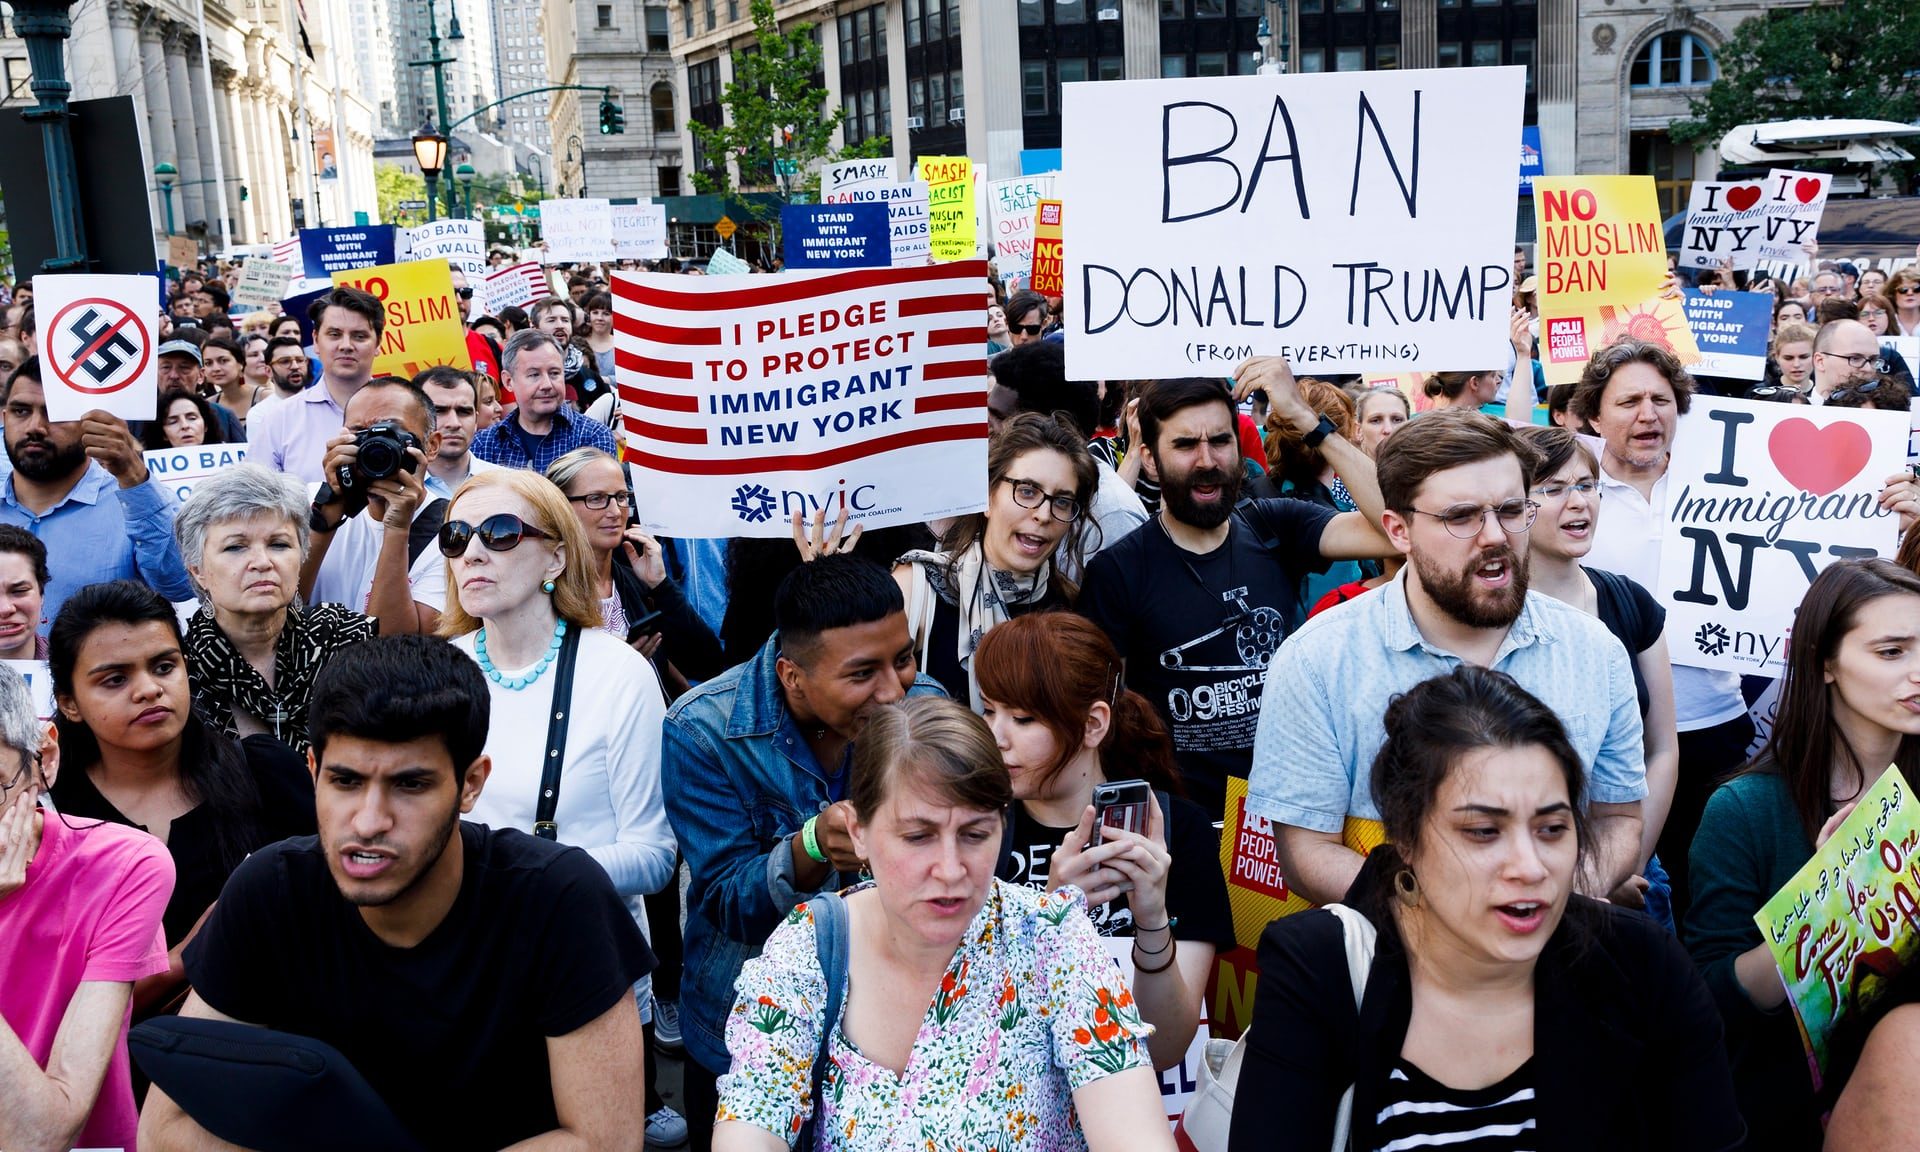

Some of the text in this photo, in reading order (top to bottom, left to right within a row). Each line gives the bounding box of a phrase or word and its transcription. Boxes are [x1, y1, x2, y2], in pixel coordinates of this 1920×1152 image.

[1162, 90, 1422, 223] BAN
[833, 164, 887, 184] SMASH
[925, 163, 967, 181] SMASH
[853, 188, 912, 201] NO BAN
[1773, 175, 1792, 201] I
[1543, 189, 1597, 222] NO
[1702, 187, 1721, 211] I
[611, 216, 658, 228] NTEGRITY
[811, 213, 855, 223] I STAND
[929, 211, 964, 222] MUSLIM
[999, 216, 1030, 234] OUT
[1688, 204, 1768, 229] Immigrant
[334, 233, 367, 242] STAND
[412, 224, 469, 243] NO BAN
[818, 225, 848, 235] WITH
[889, 223, 927, 237] AIDS
[1688, 225, 1760, 252] NY
[336, 243, 361, 251] WITH
[802, 237, 867, 247] IMMIGRANT
[997, 239, 1031, 256] NEW
[1546, 223, 1659, 258] MUSLIM
[321, 251, 378, 262] IMMIGRANT
[413, 247, 432, 261] NO
[437, 243, 480, 255] WALL
[806, 249, 865, 259] NEW YORK
[325, 260, 377, 271] NEW YORK
[464, 262, 484, 274] IDS
[1546, 259, 1606, 294] BAN
[489, 286, 529, 305] IMMIGRANT
[496, 279, 526, 295] PROTECT
[510, 295, 528, 305] YORK
[1082, 261, 1510, 335] DONALD TRUMP
[1690, 297, 1733, 308] STAND
[383, 296, 451, 327] SLIM
[1689, 309, 1723, 319] WITH
[734, 299, 887, 346] I PLEDGE
[1551, 321, 1582, 335] ACLU
[1551, 334, 1583, 347] PEOPLE
[1703, 333, 1739, 345] YORK
[705, 330, 916, 384] TO PROTECT
[1185, 342, 1421, 364] (FROM EVERYTHING)
[1552, 346, 1585, 359] POWER
[709, 364, 914, 415] IMMIGRANT
[720, 399, 903, 447] NEW YORK
[1703, 410, 1754, 487] I
[147, 455, 189, 473] NO
[868, 507, 902, 517] COALITION
[1213, 672, 1267, 695] BICYCLE
[1168, 685, 1218, 722] 09
[1216, 689, 1249, 706] FILM
[1217, 696, 1262, 718] FESTIV
[1239, 832, 1280, 863] PEOPL
[1783, 829, 1920, 983] Come for One
[1815, 925, 1865, 1009] Face
[1870, 898, 1899, 941] Us
